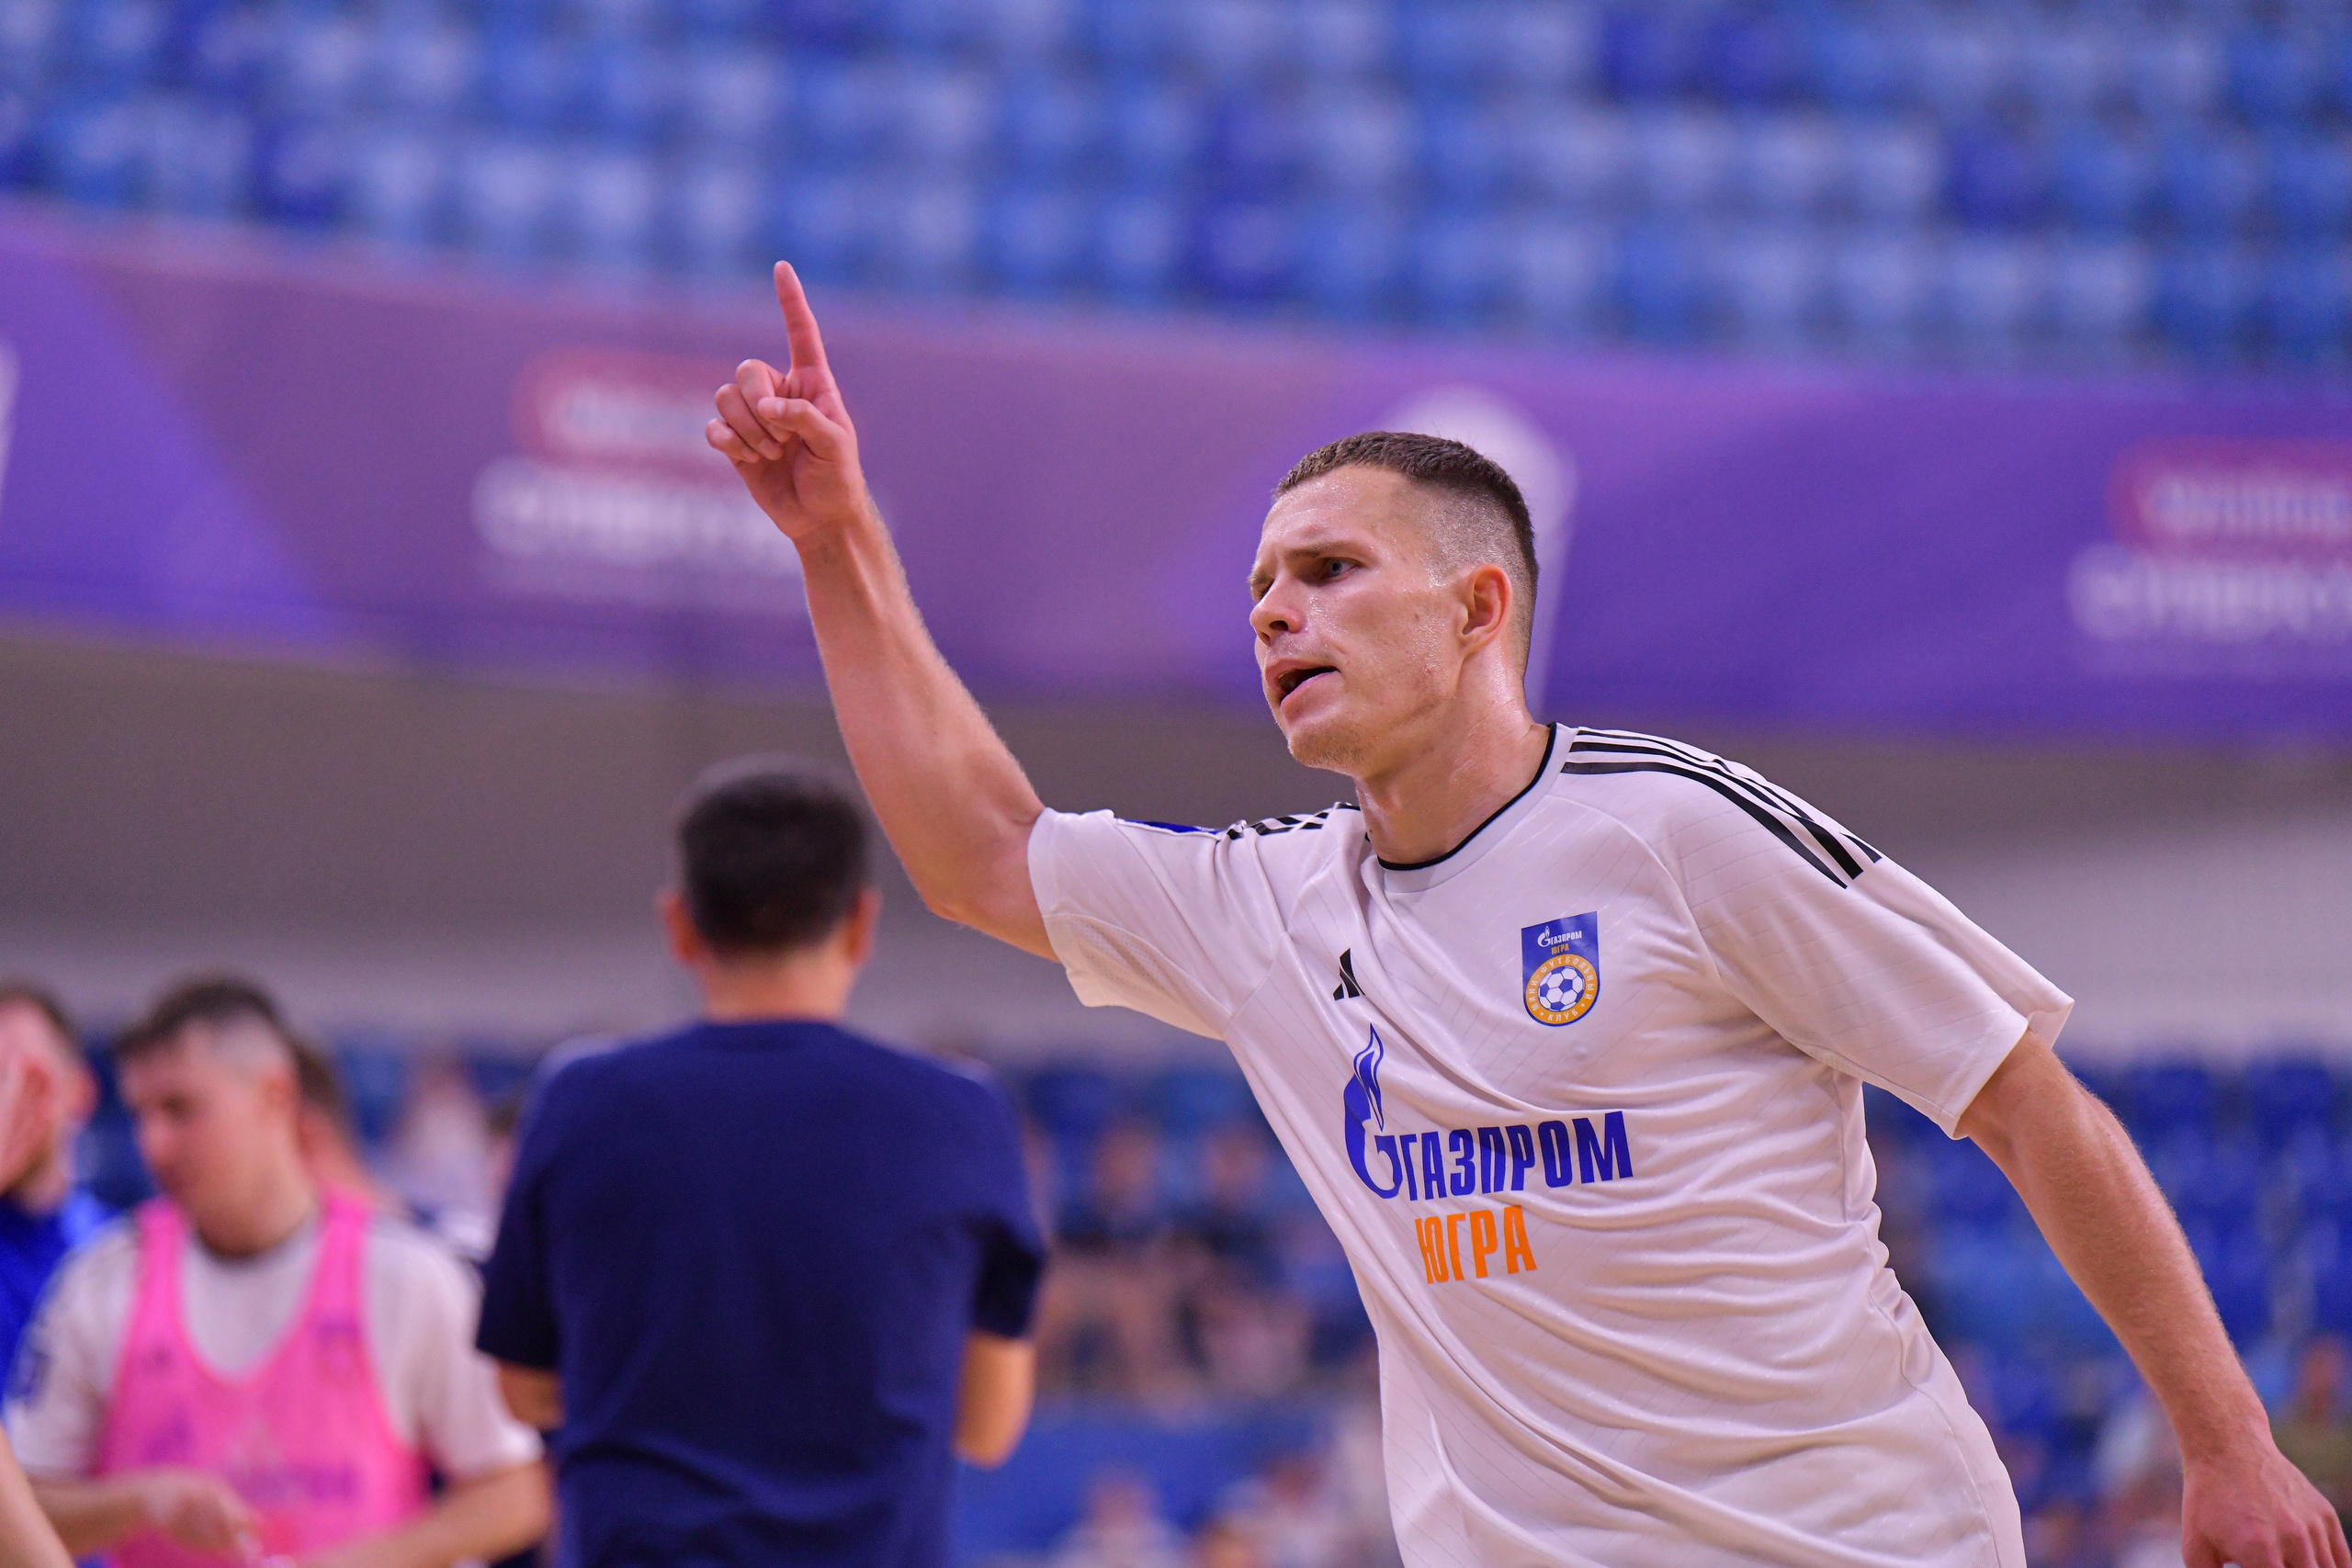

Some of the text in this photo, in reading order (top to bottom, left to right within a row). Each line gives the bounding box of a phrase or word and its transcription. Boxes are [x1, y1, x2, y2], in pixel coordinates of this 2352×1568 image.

[1550, 931, 1582, 945] ГАЗПРОМ
[1551, 943, 1569, 954] ЮГРА
[1548, 1010, 1578, 1021] КЛУБ
[1400, 1111, 1634, 1201] ГАЗПРОМ
[1415, 1204, 1537, 1284] ЮГРА
